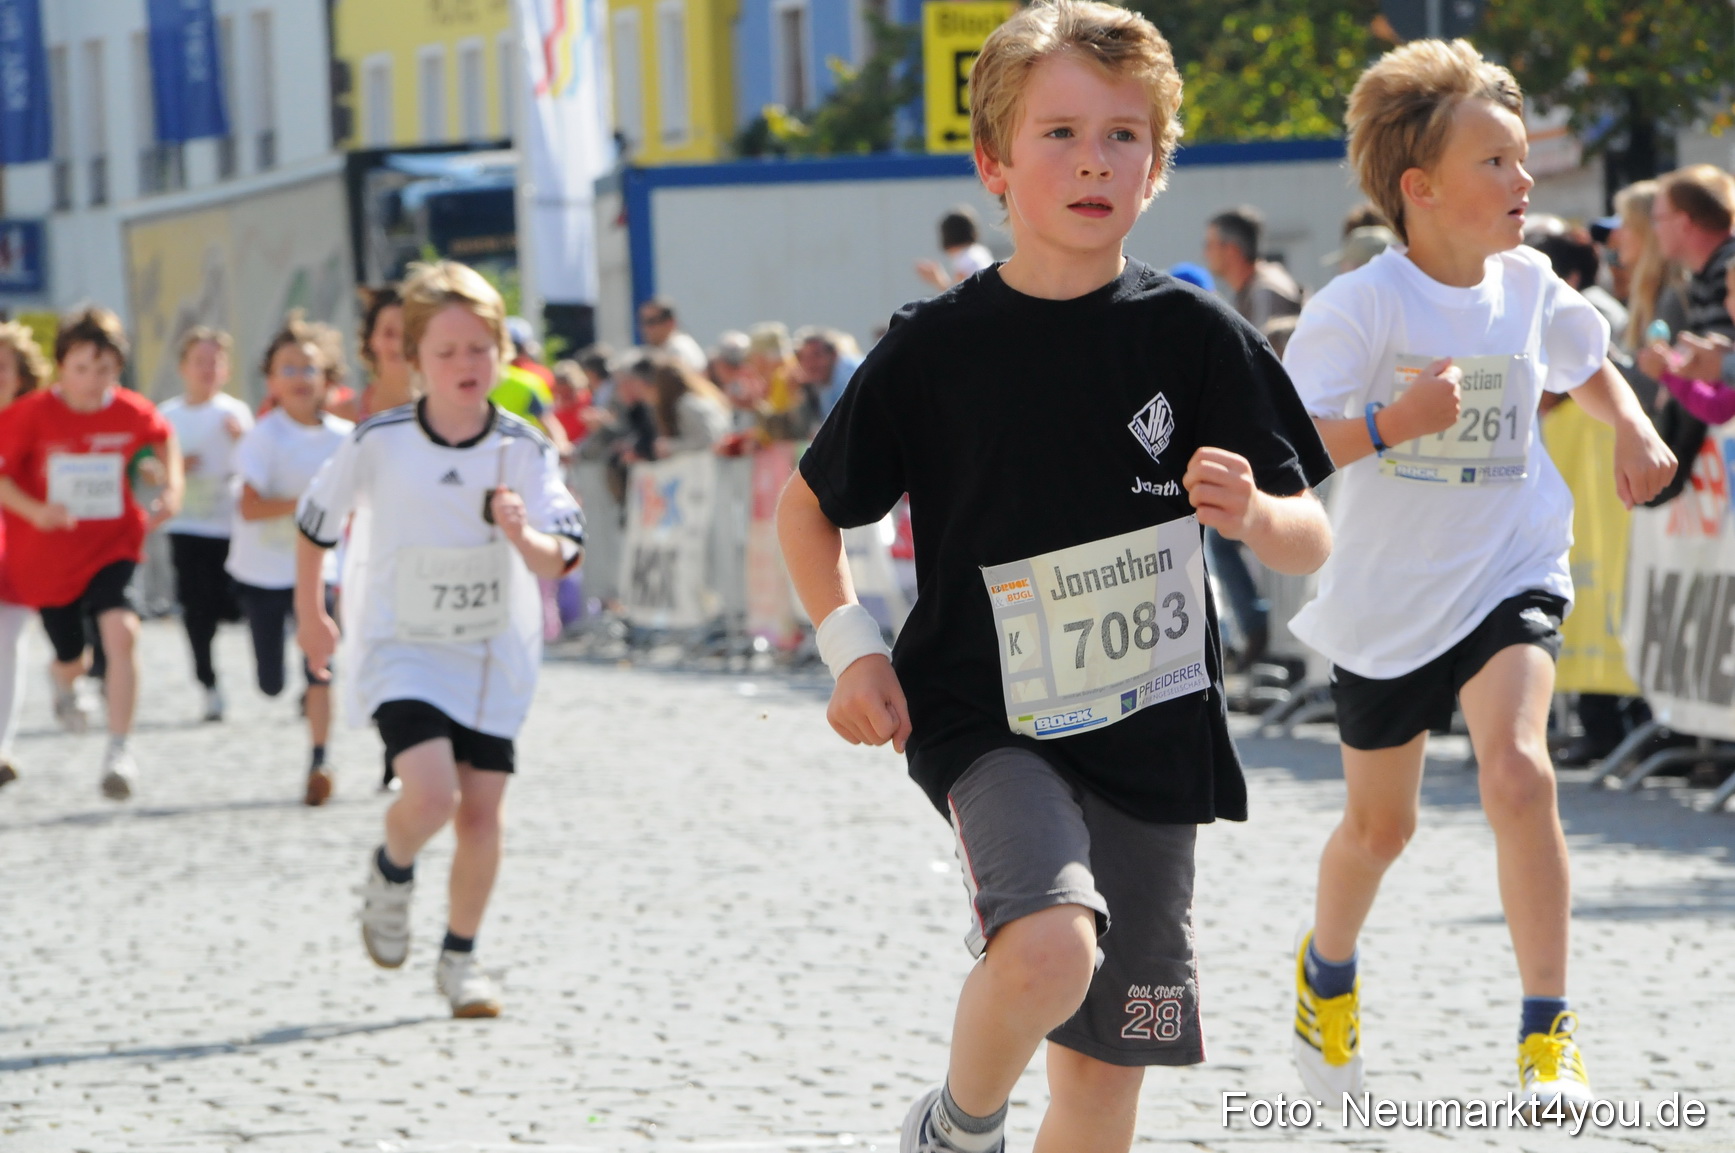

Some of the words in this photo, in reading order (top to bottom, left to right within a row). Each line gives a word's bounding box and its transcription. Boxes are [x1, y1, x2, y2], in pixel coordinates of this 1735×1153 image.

[1460, 369, 1503, 392] stian
[1437, 405, 1518, 442] 261
[1050, 548, 1174, 601] Jonathan
[431, 580, 500, 610] 7321
[1008, 631, 1023, 656] K
[1063, 591, 1190, 669] 7083
[1139, 662, 1203, 699] PFLEIDERER
[1034, 708, 1093, 731] BOCK
[1127, 984, 1153, 998] COOL
[1121, 999, 1182, 1042] 28
